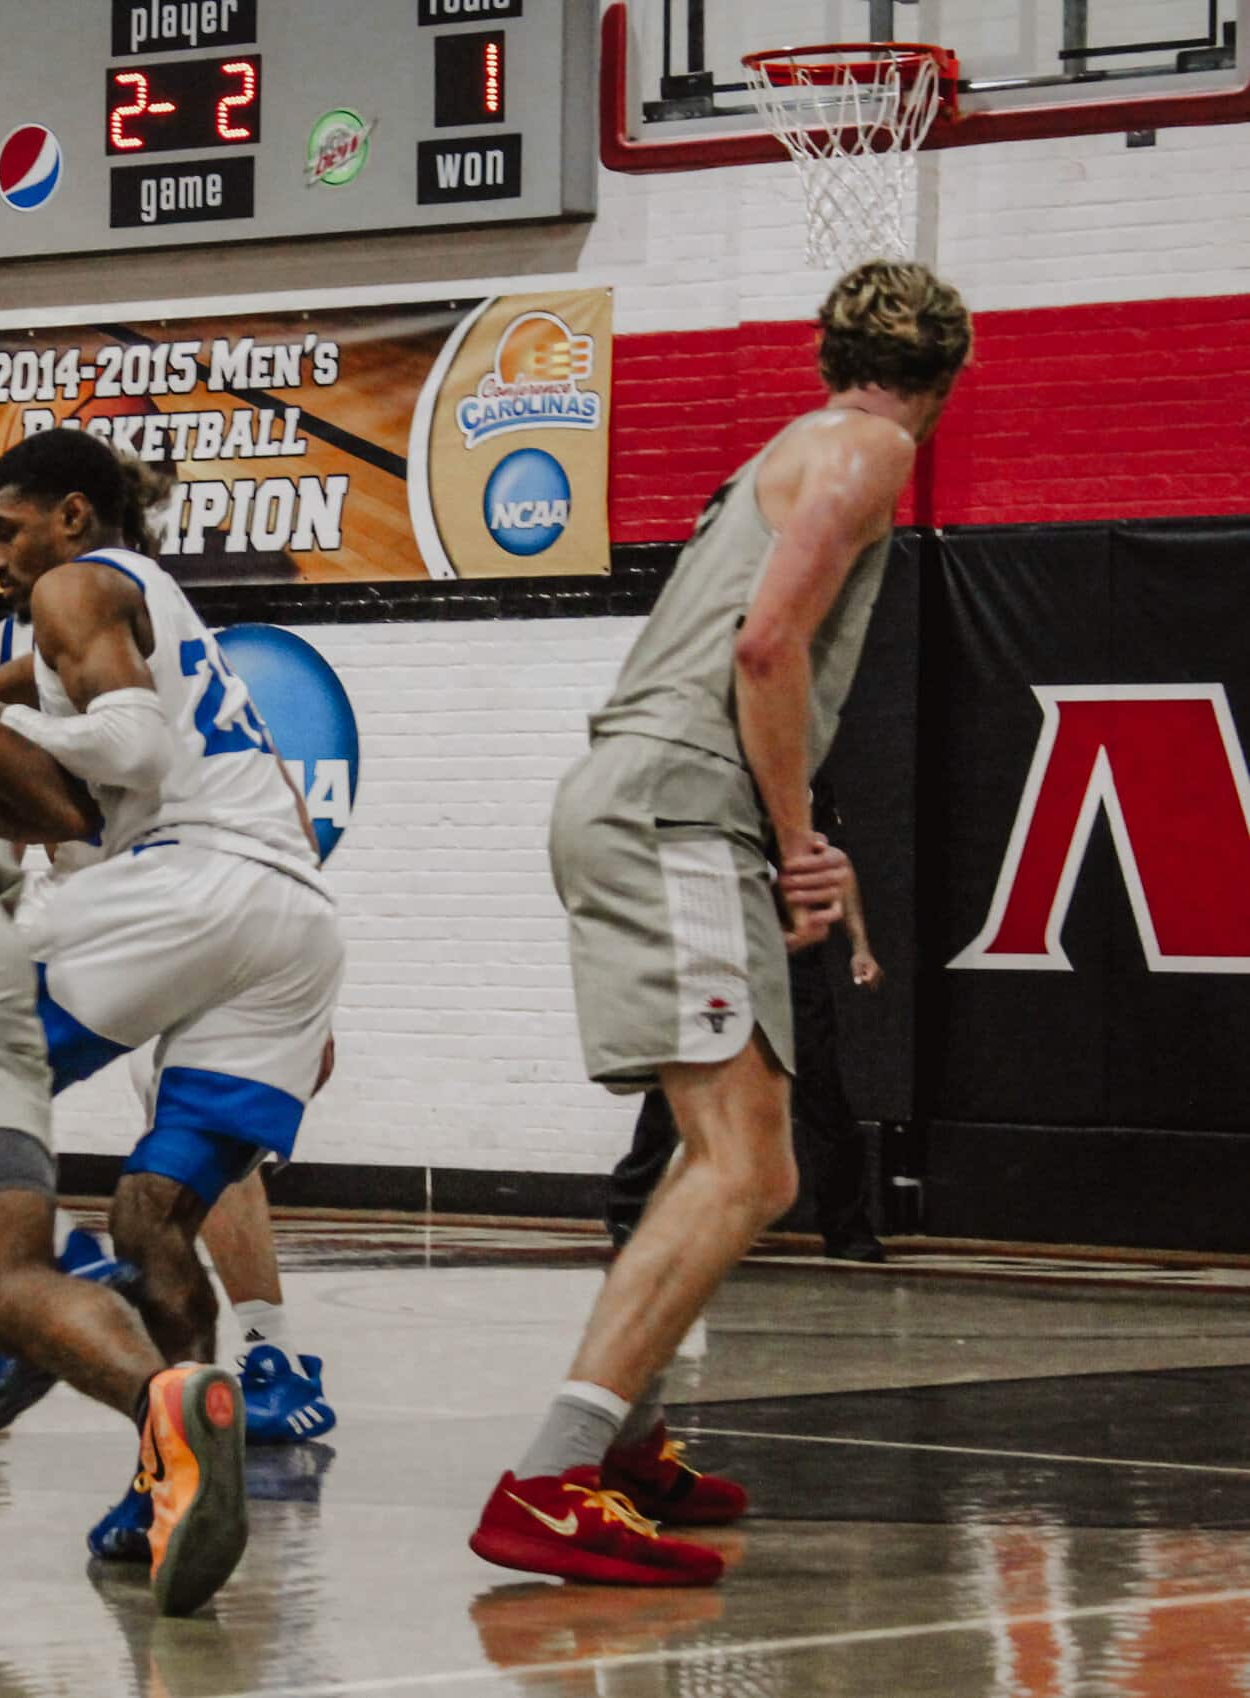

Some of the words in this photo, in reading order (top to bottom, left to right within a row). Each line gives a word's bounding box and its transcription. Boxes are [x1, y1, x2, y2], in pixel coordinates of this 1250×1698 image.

[130, 0, 238, 52] player
[485, 43, 498, 112] 1
[436, 150, 504, 189] won
[140, 174, 222, 222] game
[22, 405, 307, 462] KETBALL
[461, 397, 596, 430] CAROLINAS
[491, 499, 568, 530] NCAA
